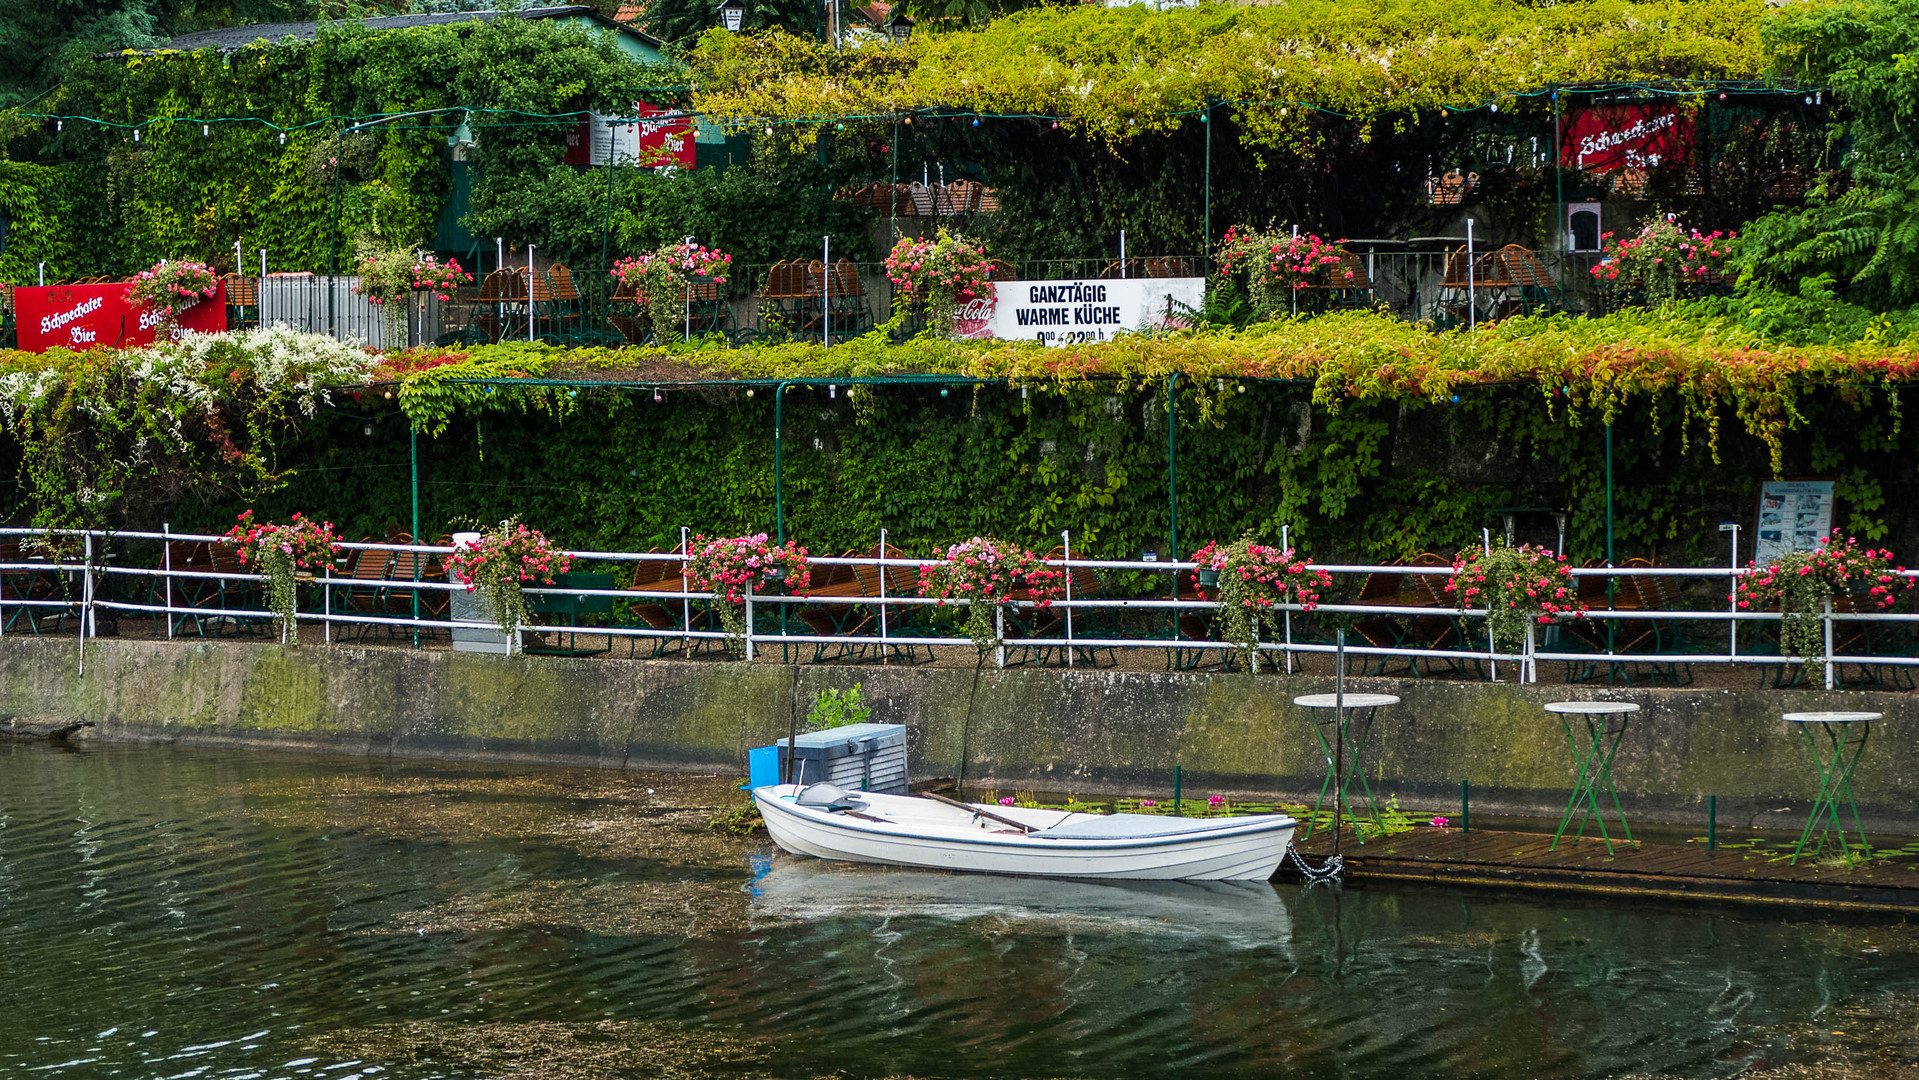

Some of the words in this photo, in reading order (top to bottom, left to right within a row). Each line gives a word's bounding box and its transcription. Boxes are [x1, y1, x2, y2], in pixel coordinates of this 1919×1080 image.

[1029, 282, 1107, 304] GANZTÄGIG
[40, 297, 103, 335] Schwechater
[1016, 308, 1070, 326] WARME
[1074, 303, 1121, 325] KÜCHE
[70, 325, 97, 345] Bier
